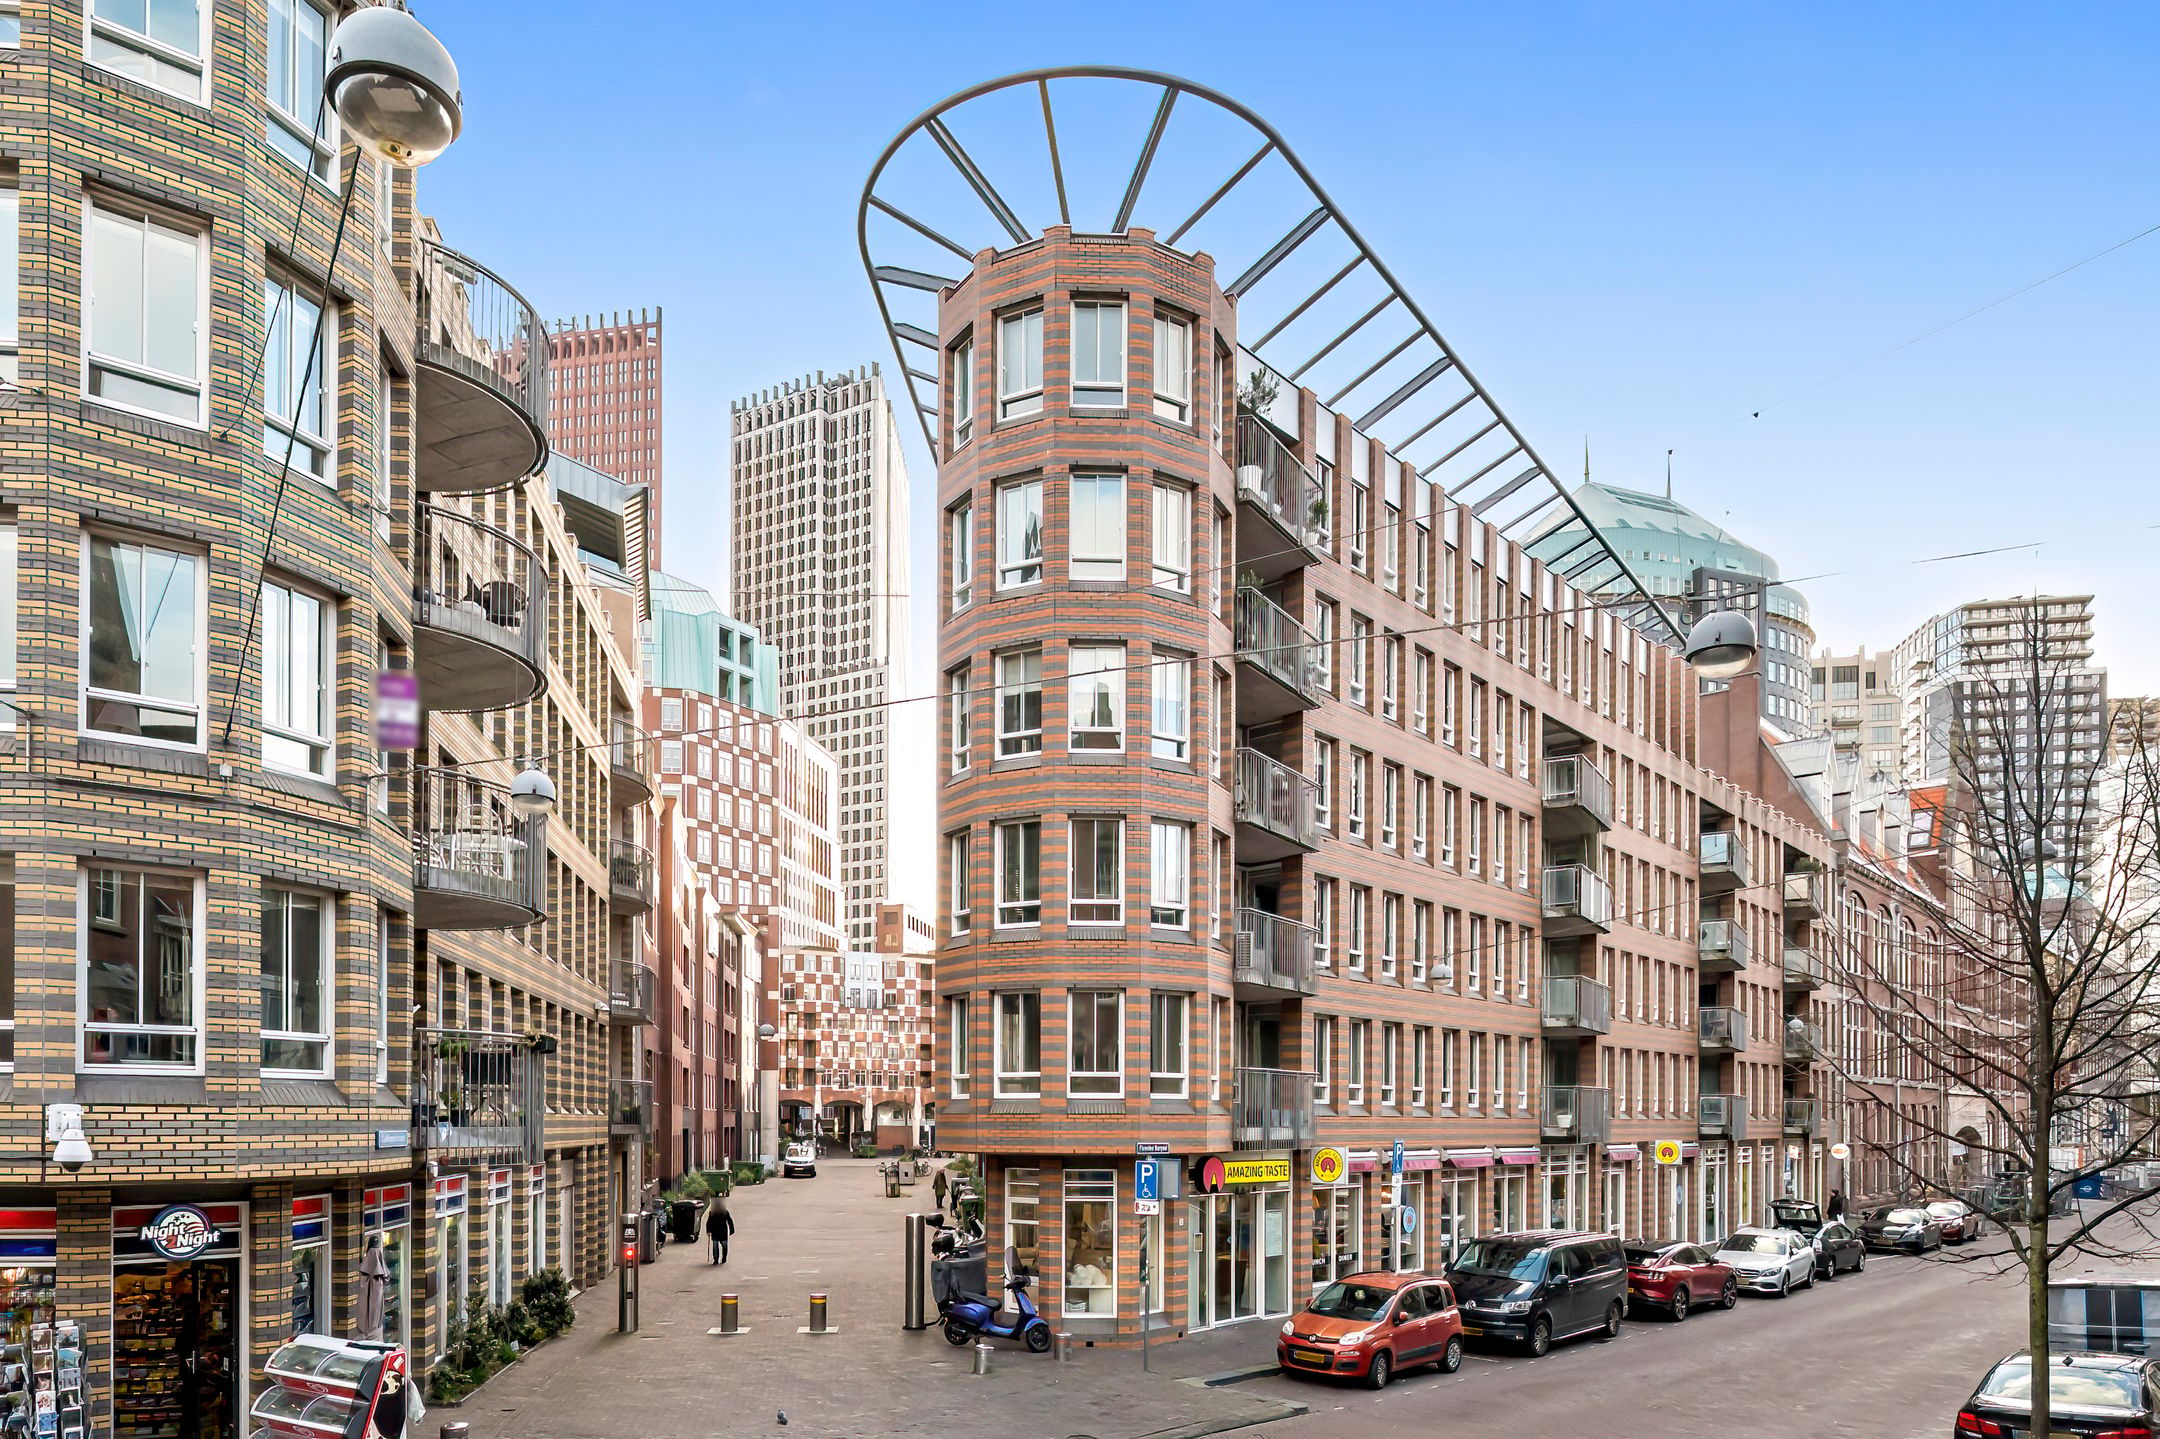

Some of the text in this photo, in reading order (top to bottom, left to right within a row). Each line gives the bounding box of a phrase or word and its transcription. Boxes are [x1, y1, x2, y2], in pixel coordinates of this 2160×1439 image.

[1141, 1164, 1154, 1183] P
[1227, 1164, 1288, 1178] AMAZING TASTE
[141, 1223, 186, 1240] Night
[176, 1230, 221, 1248] Night
